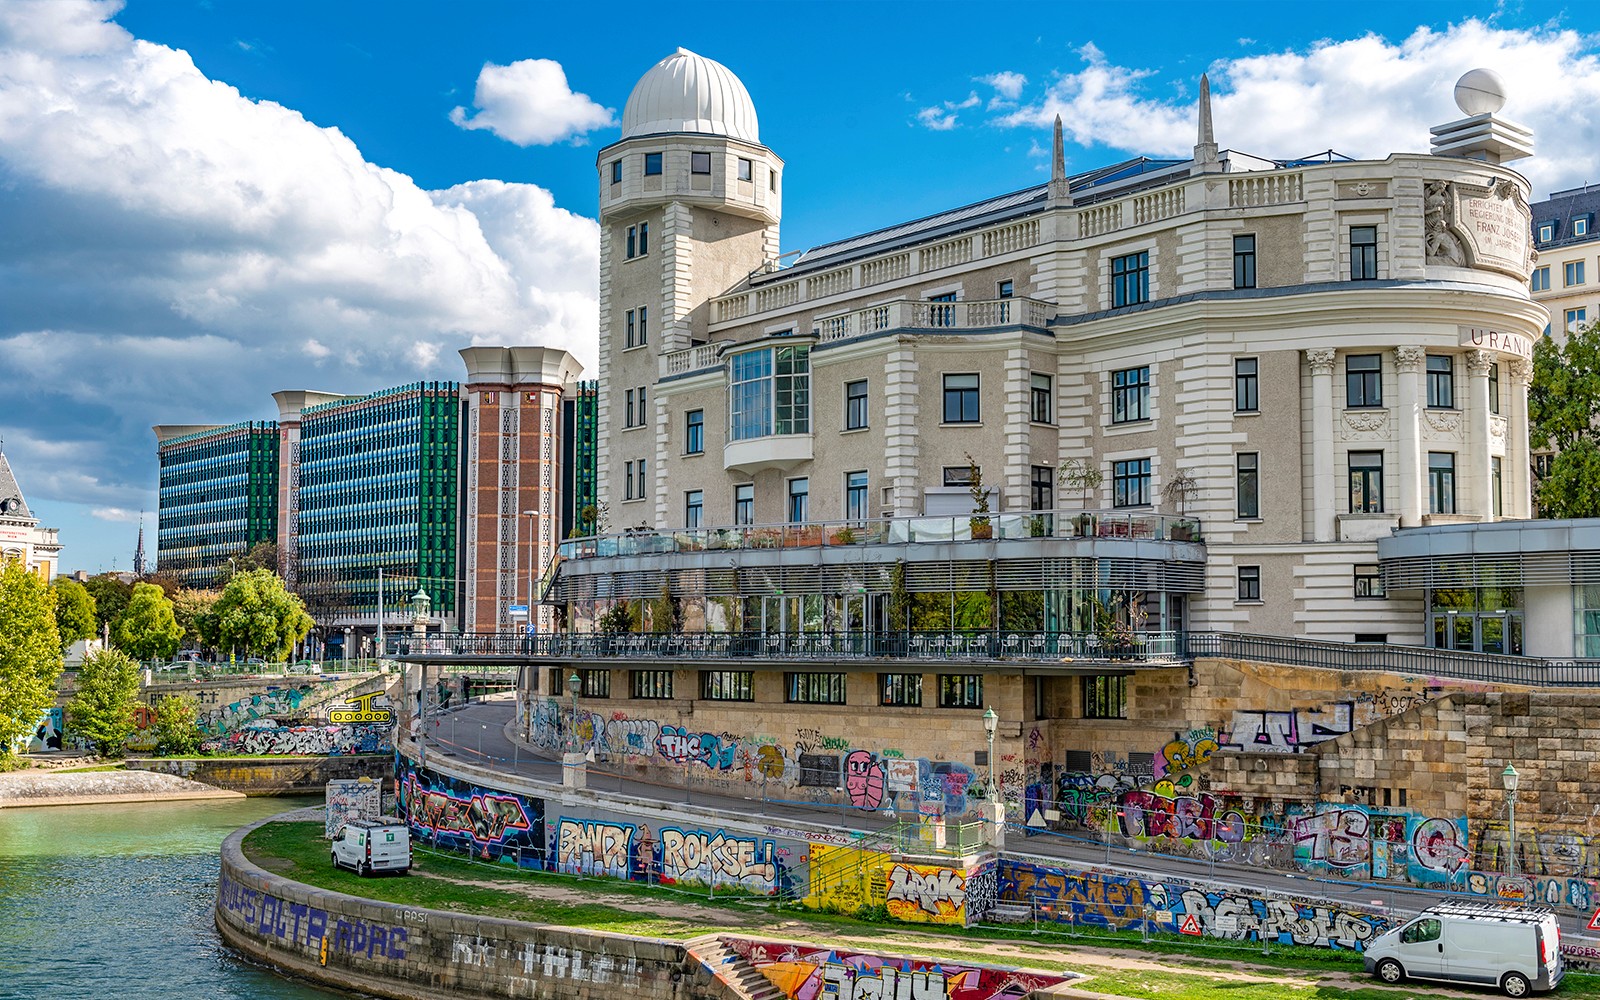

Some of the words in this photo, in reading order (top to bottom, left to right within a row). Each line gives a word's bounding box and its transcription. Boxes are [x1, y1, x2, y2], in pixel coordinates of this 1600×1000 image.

[1469, 199, 1503, 213] ERRICHTET
[1469, 208, 1505, 223] REGIERUNG
[1476, 221, 1500, 236] FRANZ
